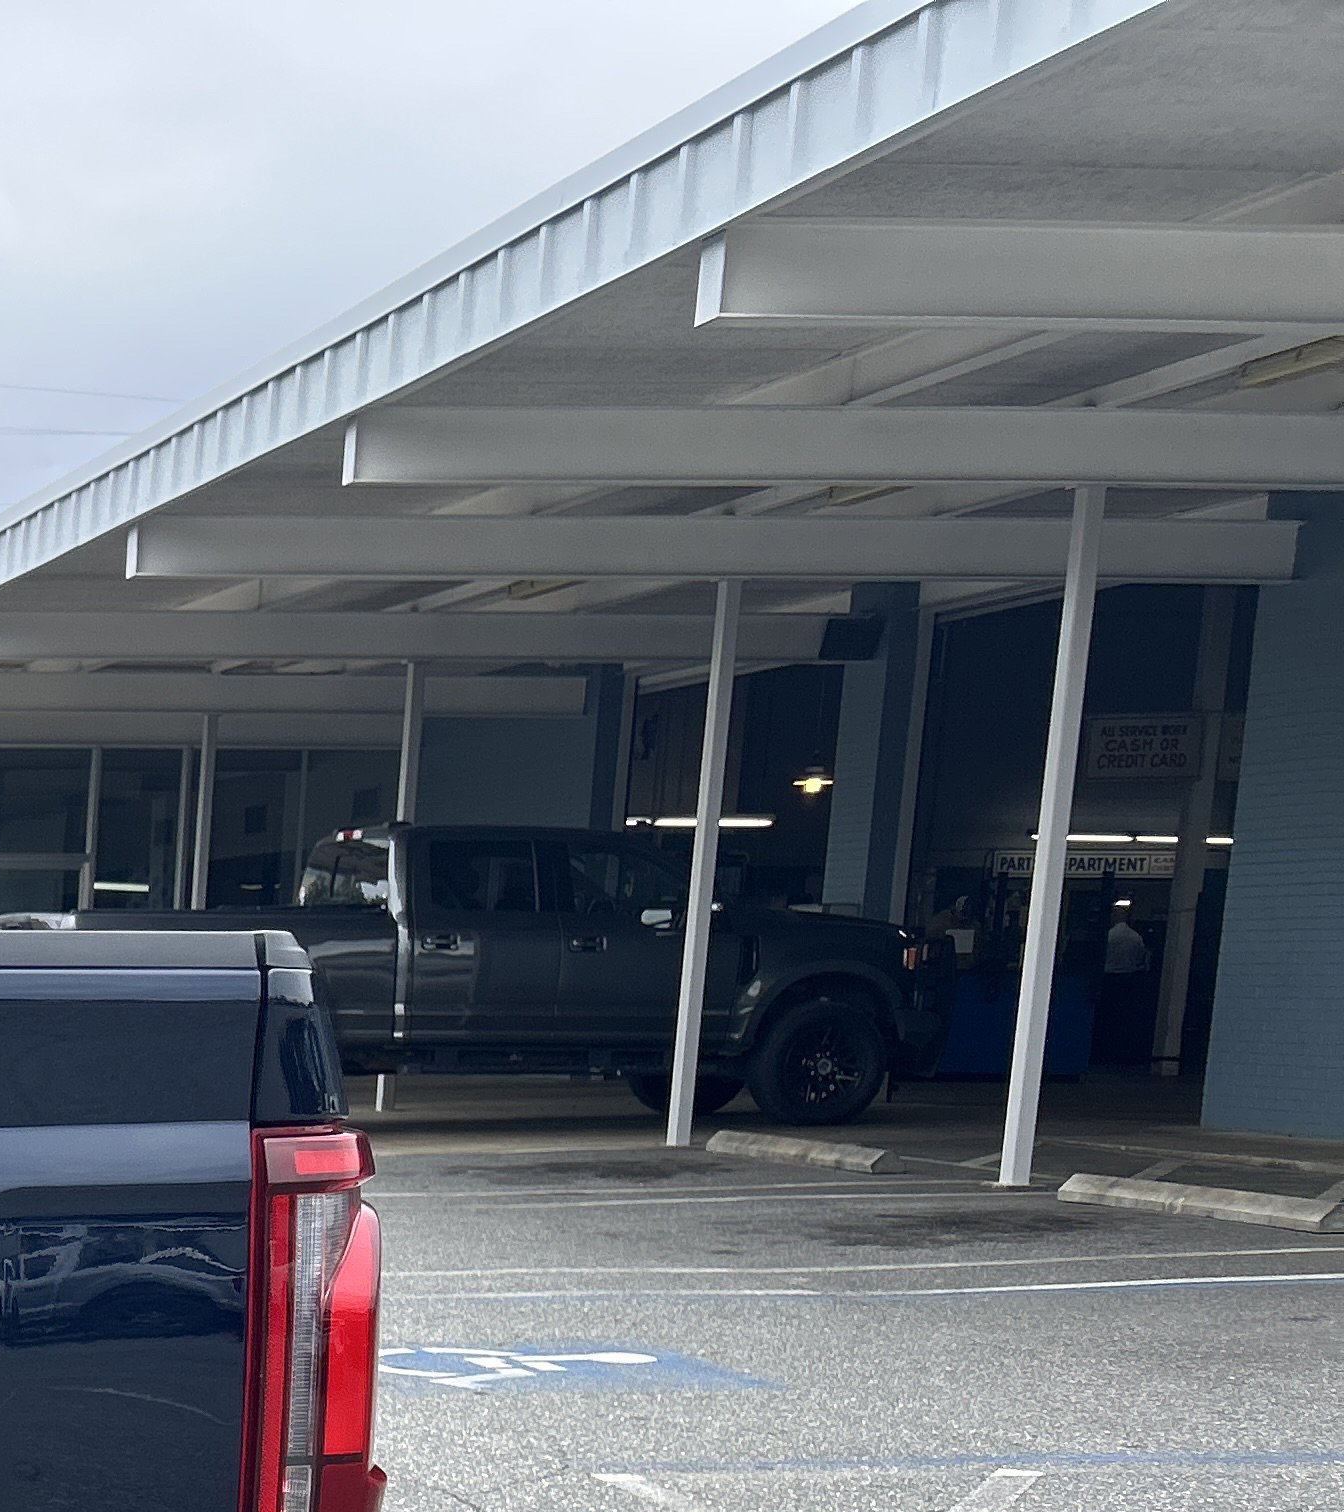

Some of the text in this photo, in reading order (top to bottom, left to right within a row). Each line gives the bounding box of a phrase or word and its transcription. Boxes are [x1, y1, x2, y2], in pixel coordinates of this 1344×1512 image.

[1119, 725, 1158, 737] SERVICE
[1104, 737, 1180, 752] CASH OR
[1097, 753, 1187, 769] CREDIT CARD
[1000, 856, 1033, 871] PART
